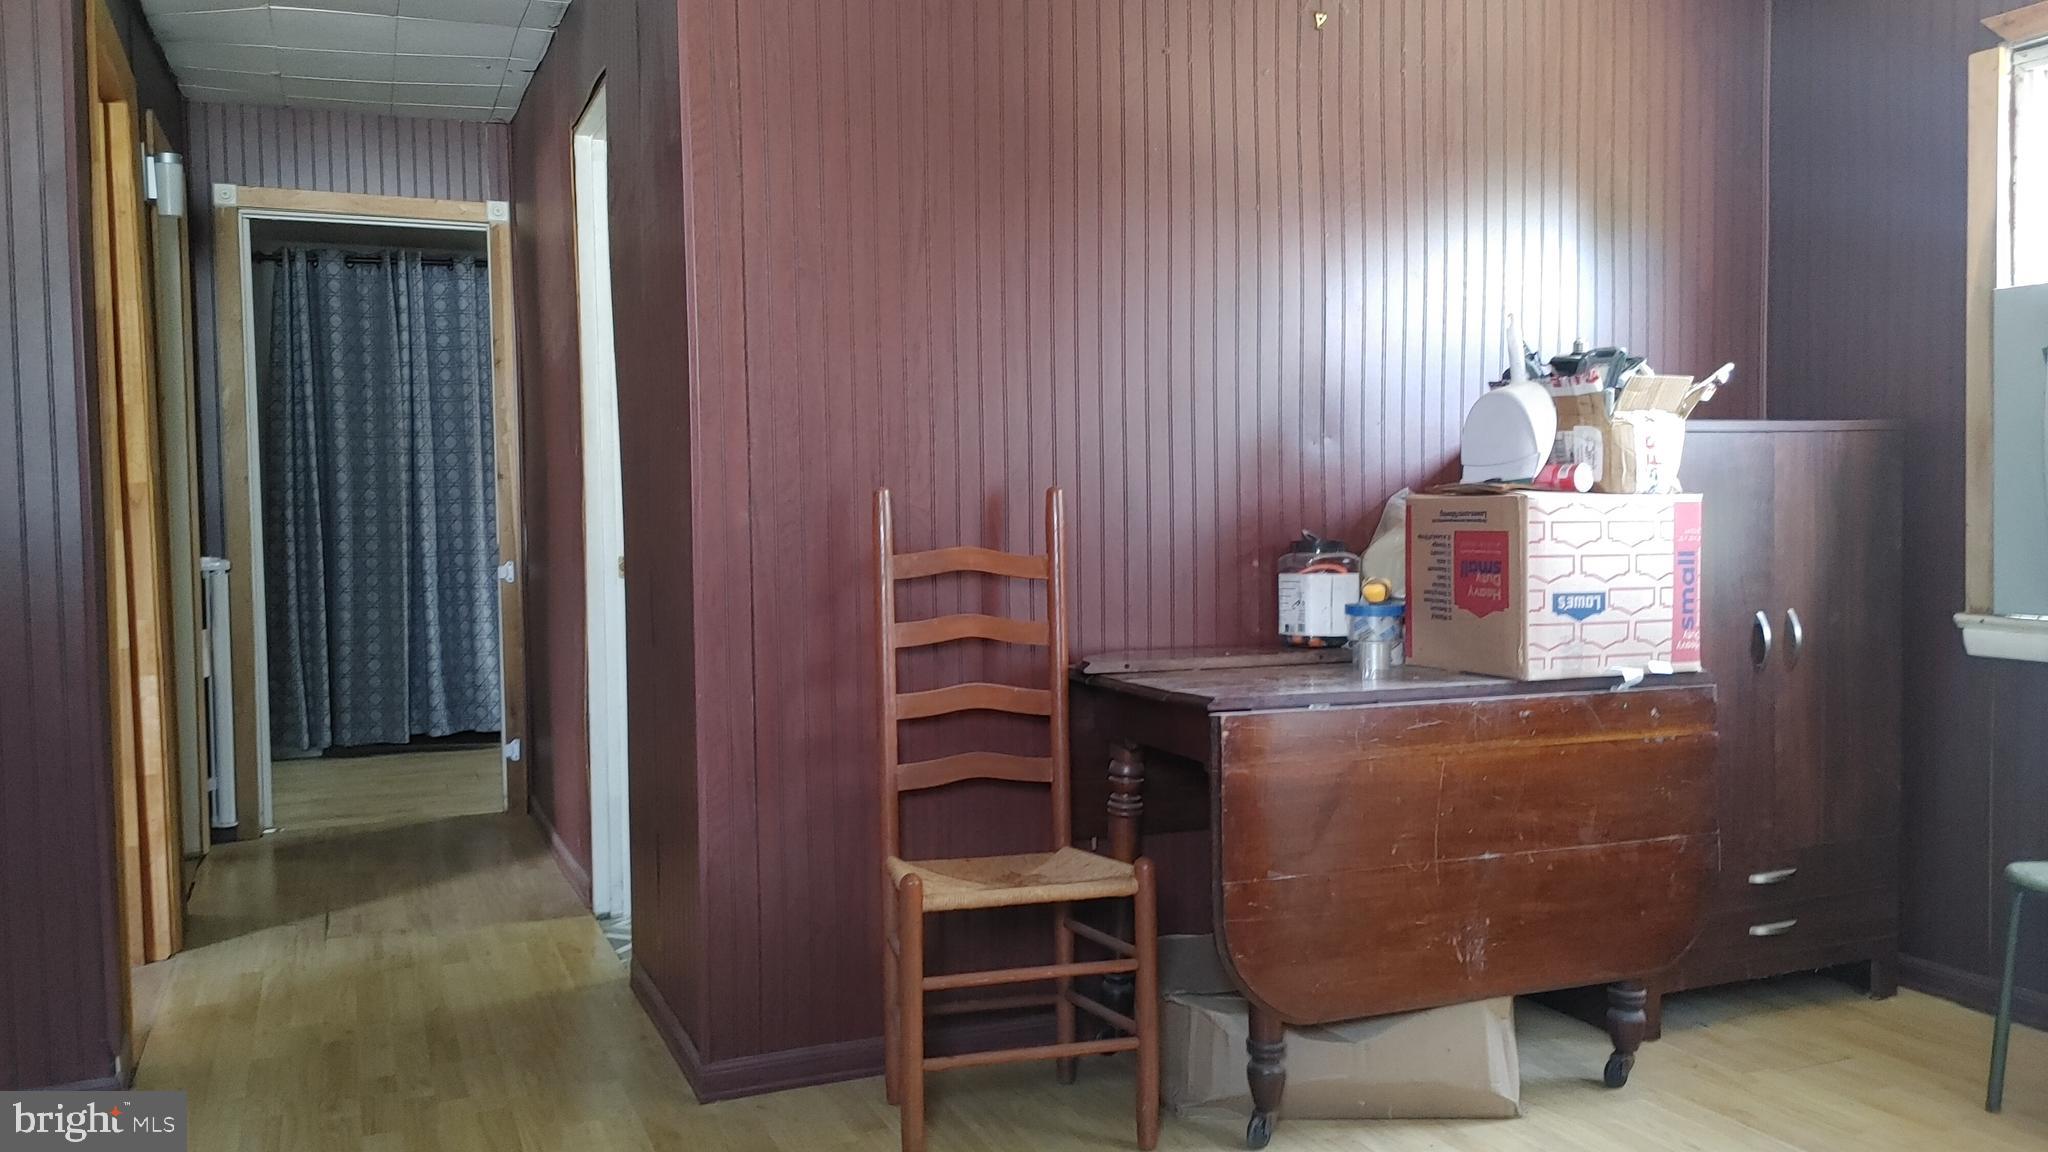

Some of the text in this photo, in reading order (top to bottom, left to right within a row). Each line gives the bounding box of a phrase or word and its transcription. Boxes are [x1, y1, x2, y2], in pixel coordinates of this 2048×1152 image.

[1460, 560, 1502, 578] small
[1467, 584, 1502, 601] Heavy
[1677, 551, 1695, 630] small
[1557, 594, 1601, 610] LOWE'S
